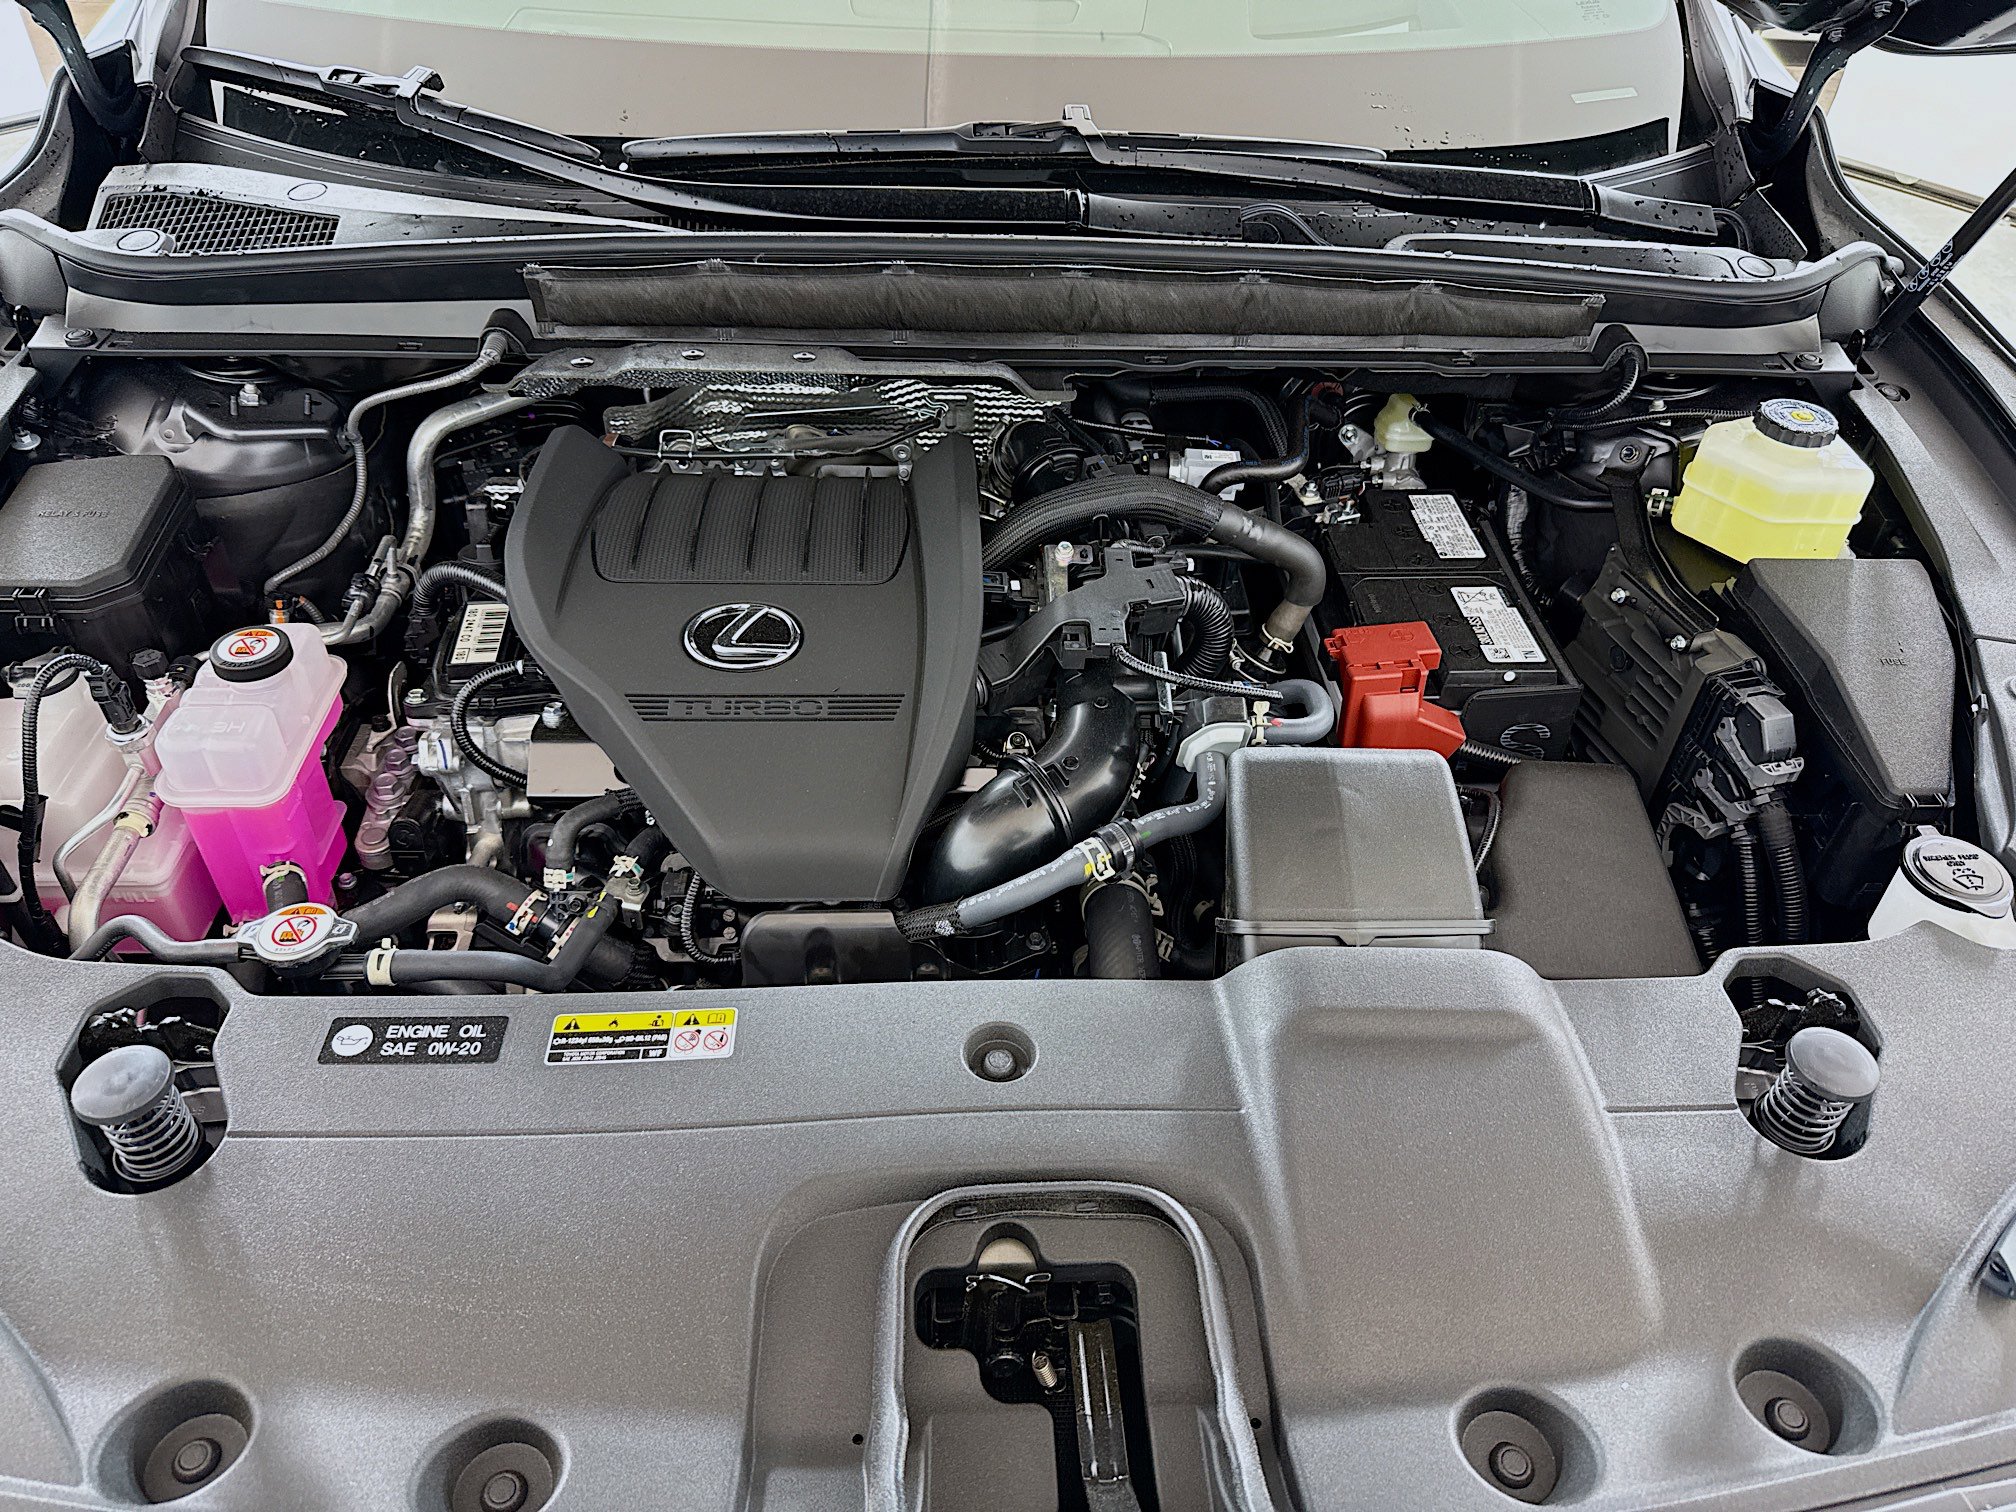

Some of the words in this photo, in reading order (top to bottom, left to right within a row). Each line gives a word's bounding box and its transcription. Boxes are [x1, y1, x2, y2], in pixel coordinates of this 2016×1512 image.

[1880, 657, 1908, 667] FUSE
[673, 698, 823, 717] TURBO
[385, 1024, 450, 1039] ENGINE
[458, 1024, 488, 1038] OIL
[379, 1041, 416, 1056] SAE
[427, 1041, 482, 1056] 0W-20
